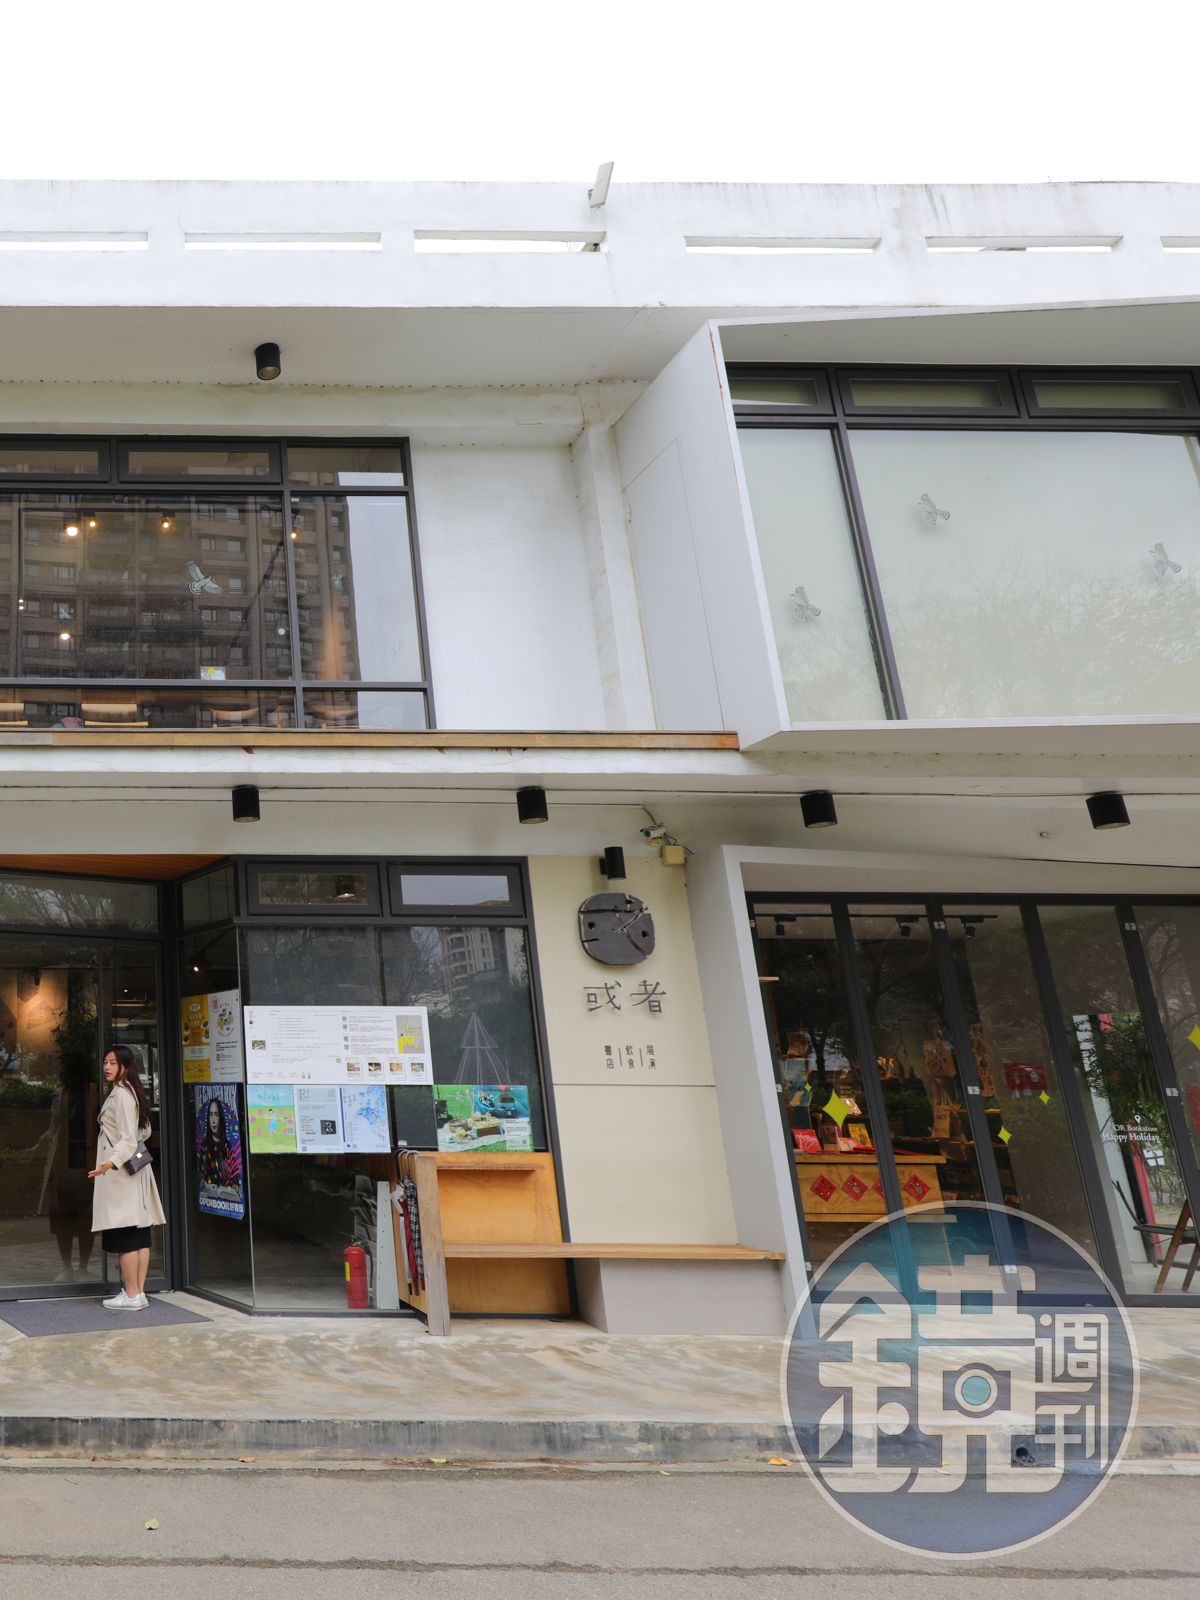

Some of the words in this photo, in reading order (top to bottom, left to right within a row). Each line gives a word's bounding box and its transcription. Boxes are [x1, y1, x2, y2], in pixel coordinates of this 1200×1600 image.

[582, 980, 667, 1013] 或者
[604, 1045, 615, 1069] 書店
[1128, 1131, 1160, 1144] Holiday
